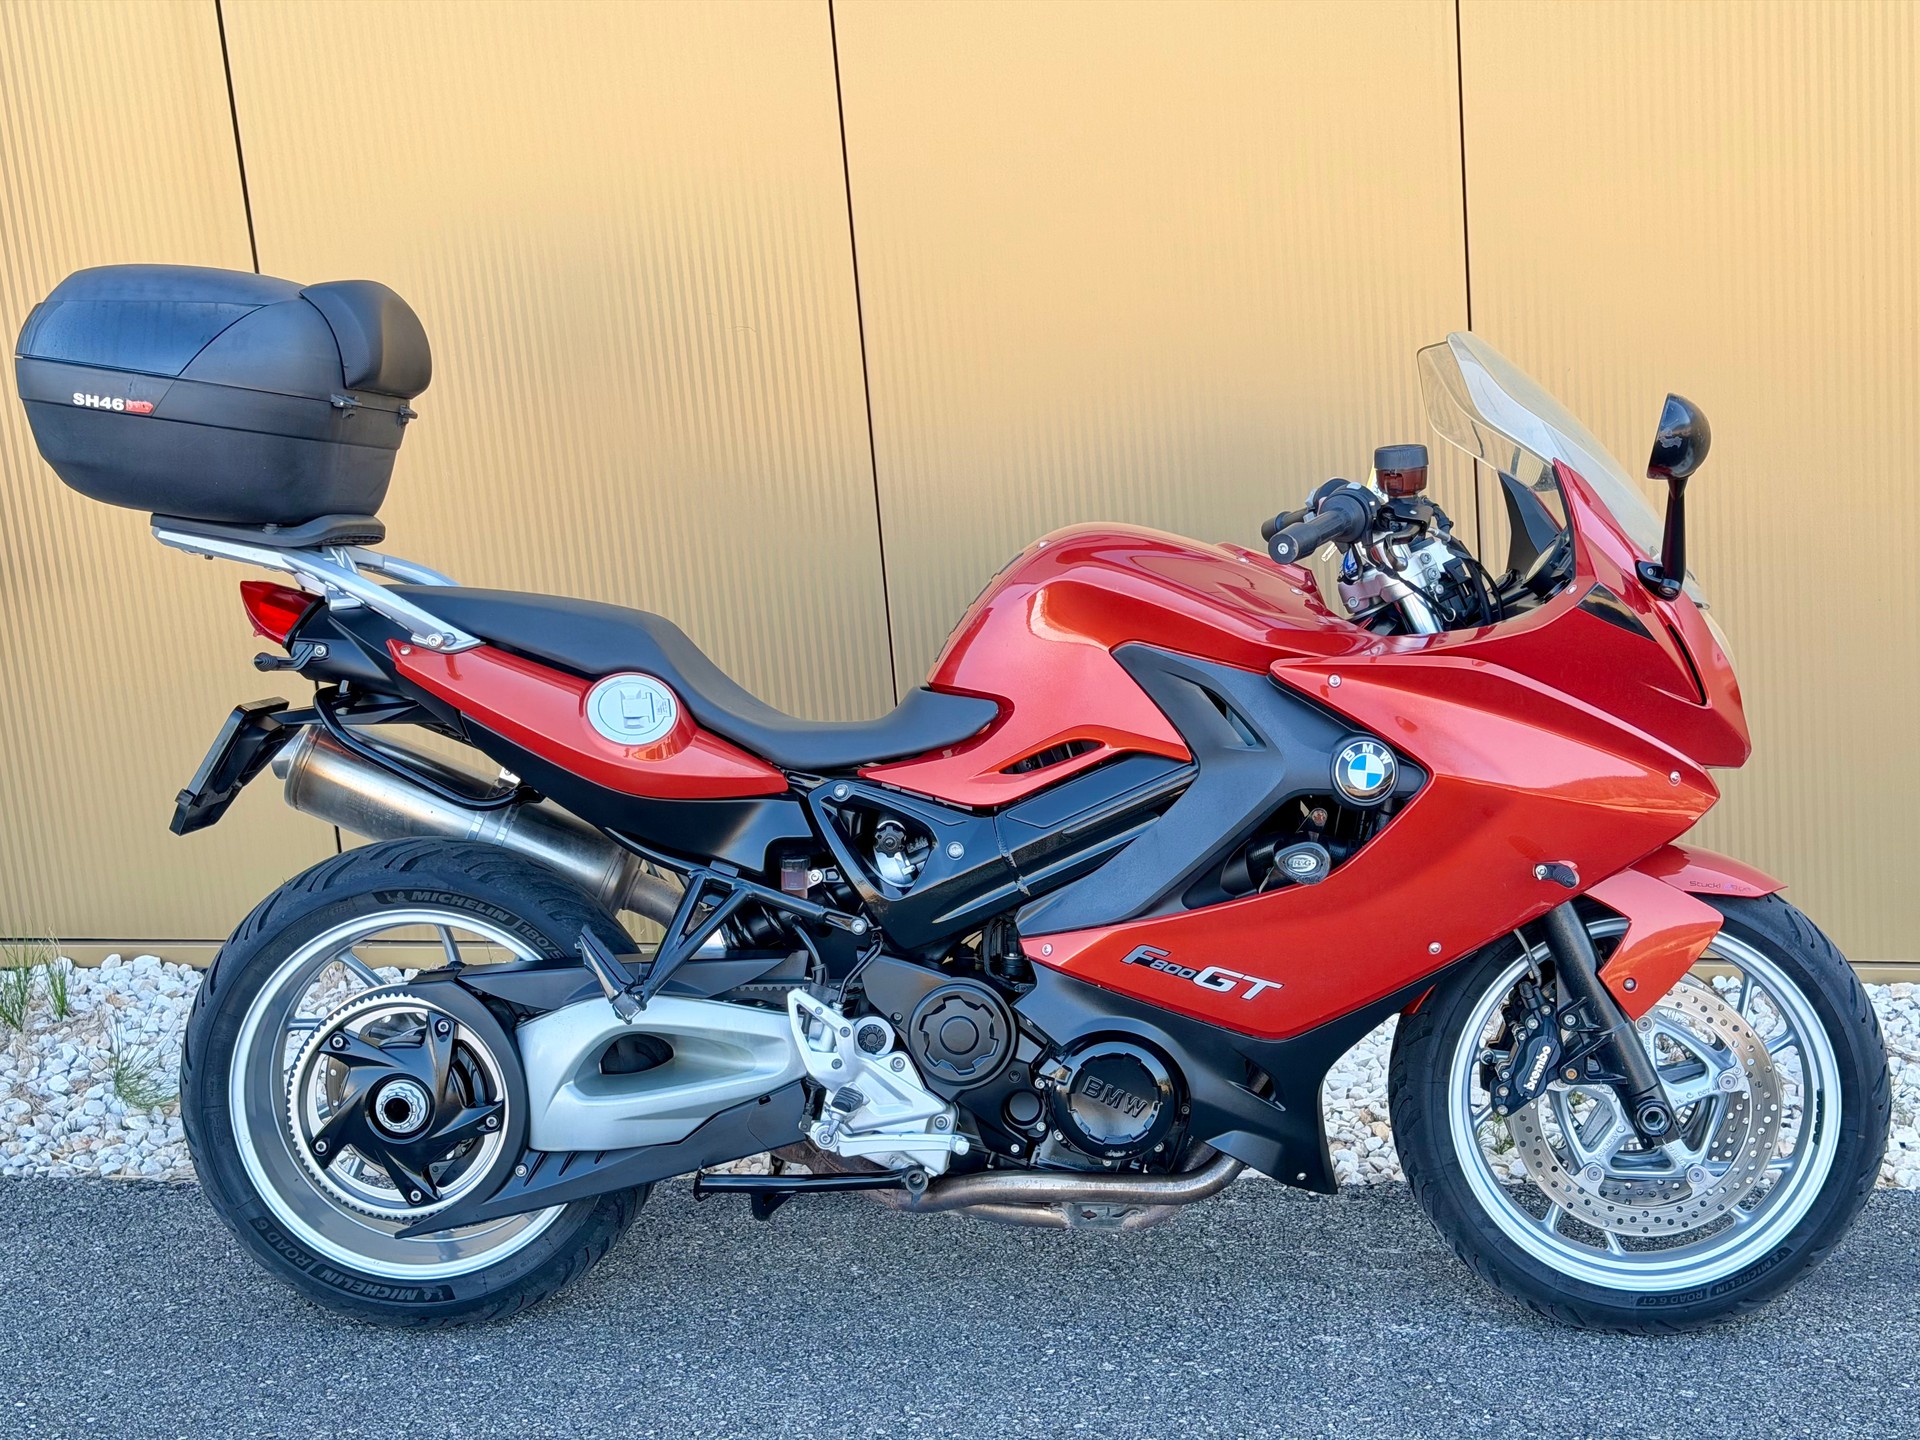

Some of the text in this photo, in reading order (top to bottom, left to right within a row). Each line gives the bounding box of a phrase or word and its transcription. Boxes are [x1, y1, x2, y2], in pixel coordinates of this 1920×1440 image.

[72, 392, 125, 411] SH46
[1342, 743, 1393, 764] BMW
[411, 890, 509, 922] MICHELIN
[1523, 1045, 1551, 1091] brembo
[1081, 1075, 1148, 1118] BMW
[253, 1218, 421, 1301] MICHELIN ROAD 6
[1715, 1260, 1773, 1295] MICHELIN
[1670, 1290, 1704, 1304] ROAD
